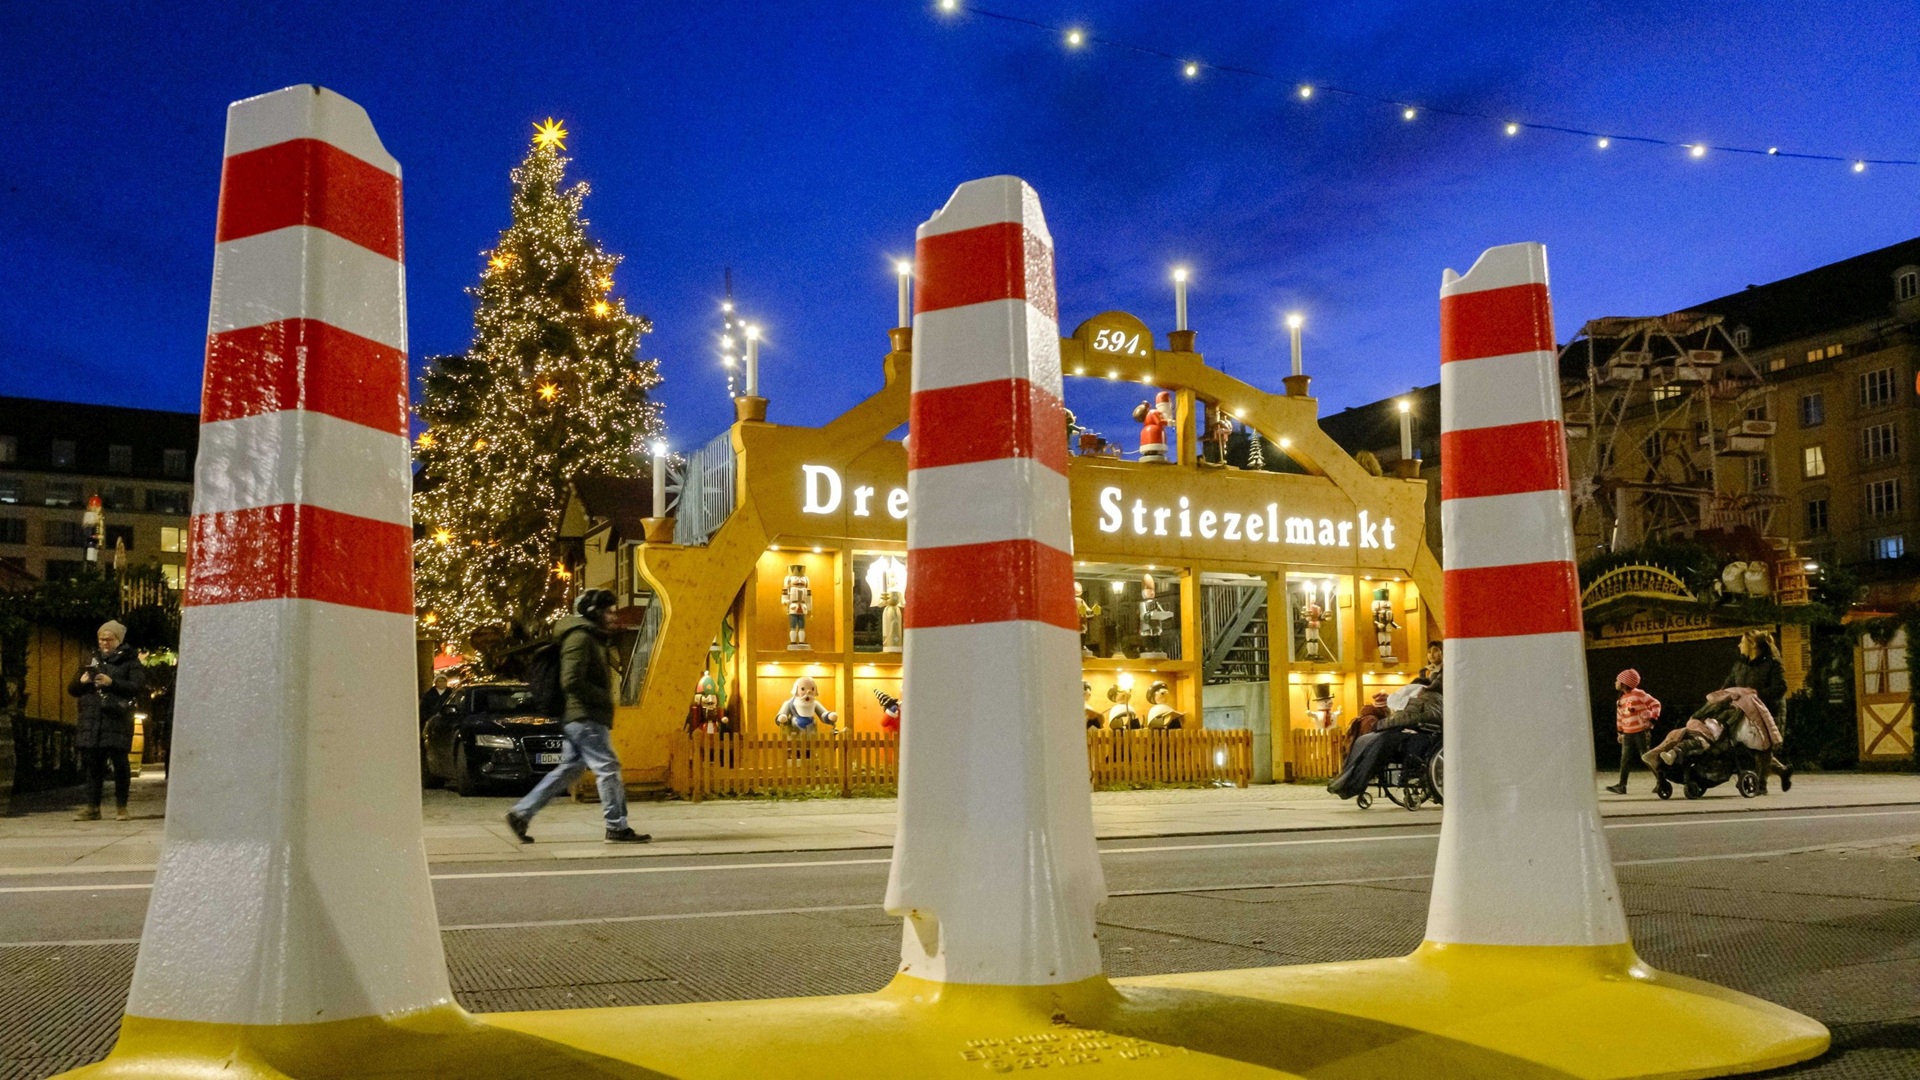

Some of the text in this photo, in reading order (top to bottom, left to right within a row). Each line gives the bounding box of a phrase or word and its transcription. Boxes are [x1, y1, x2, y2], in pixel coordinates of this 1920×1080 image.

[1093, 329, 1147, 357] 591.
[802, 464, 1396, 550] Dre Striezelmarkt
